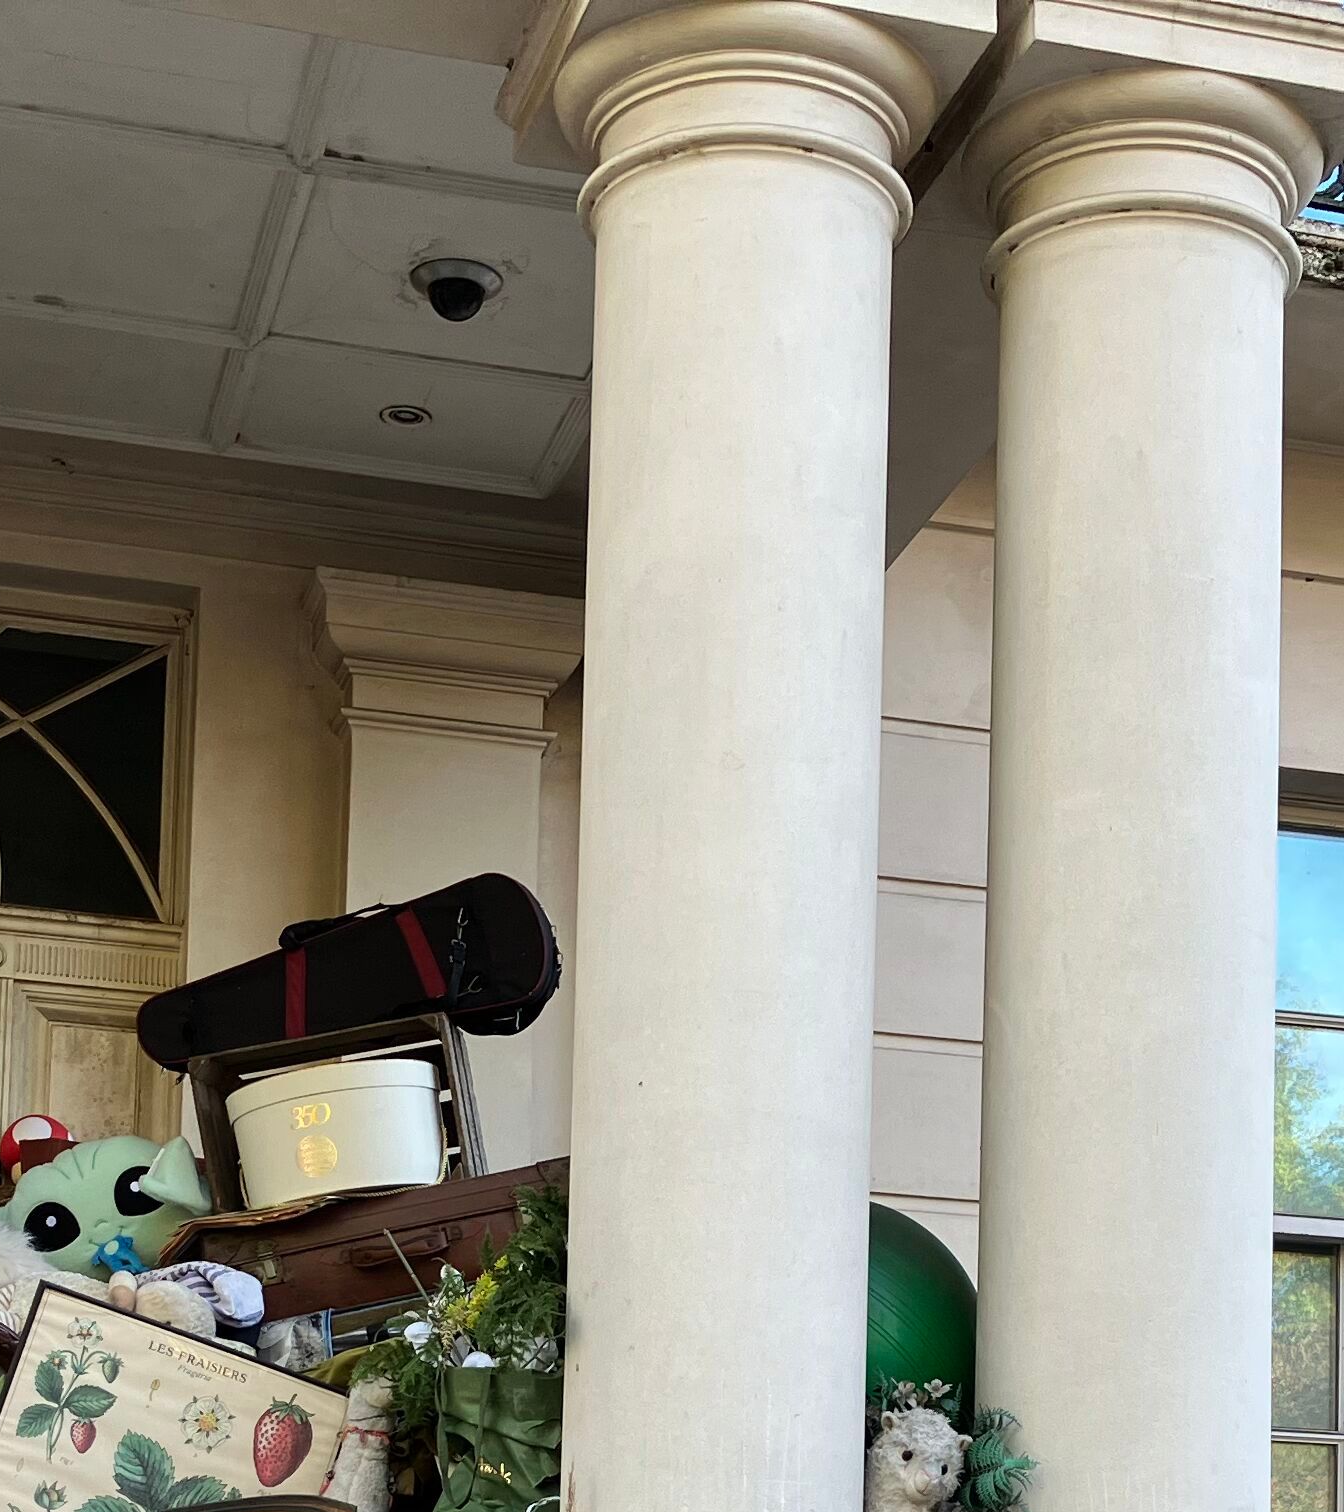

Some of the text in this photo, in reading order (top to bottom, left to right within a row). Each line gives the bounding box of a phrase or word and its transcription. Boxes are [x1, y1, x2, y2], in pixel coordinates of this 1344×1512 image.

[290, 1102, 332, 1130] 350
[148, 1340, 248, 1384] LES FRAISIERS
